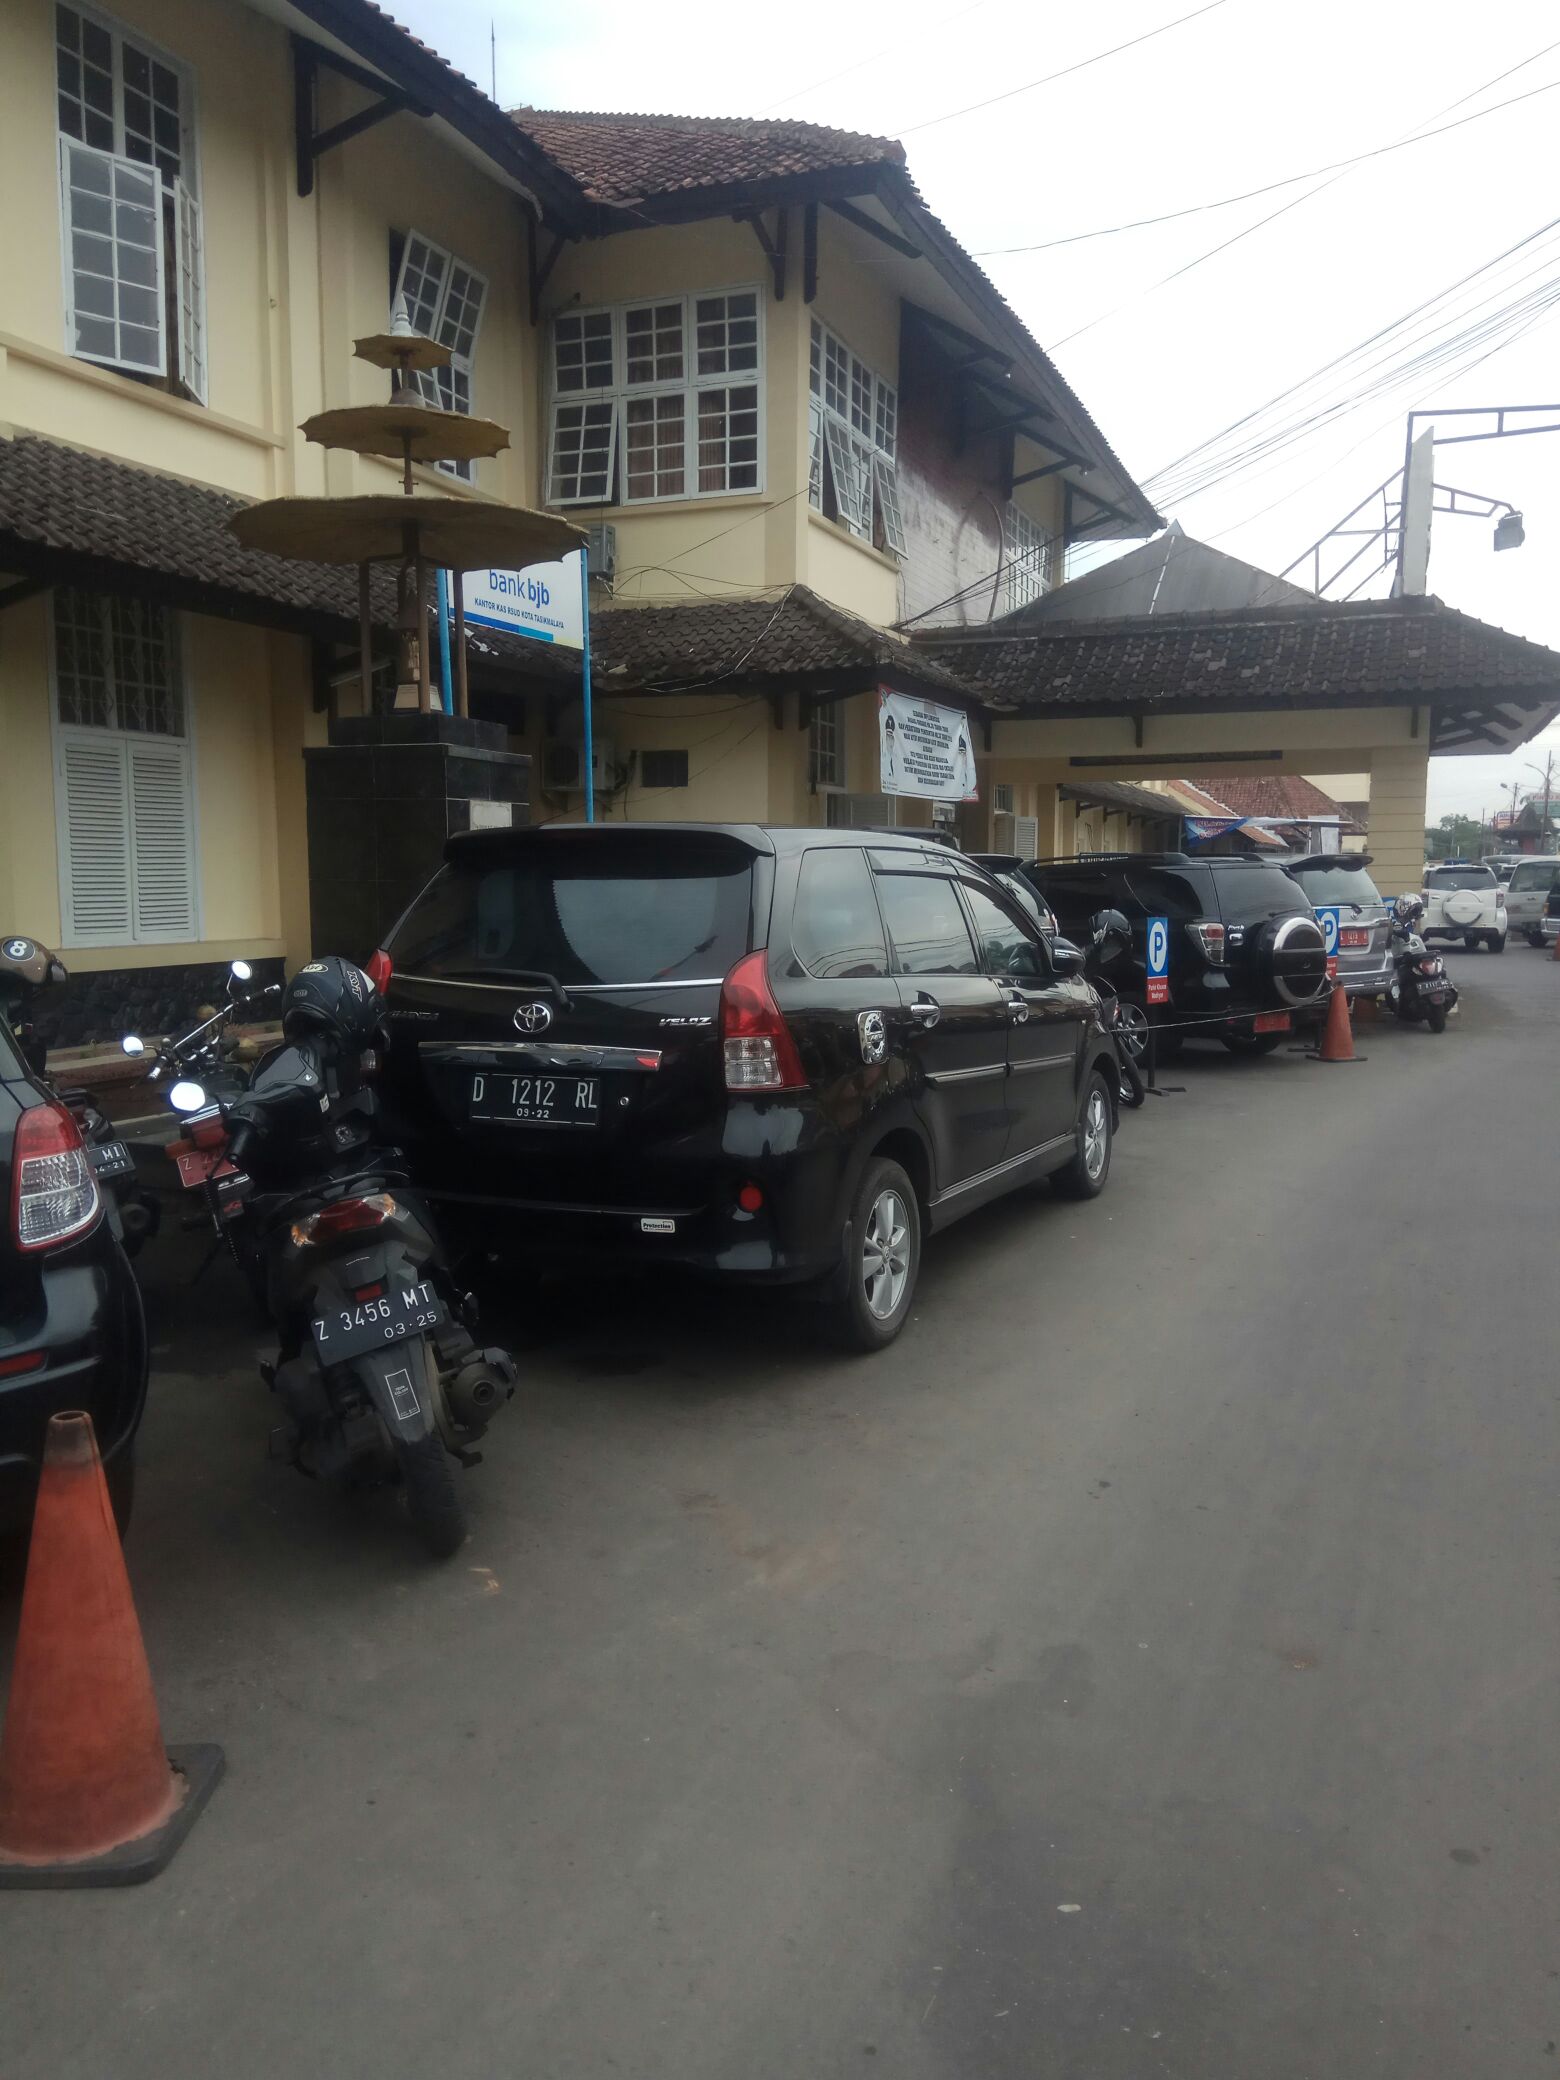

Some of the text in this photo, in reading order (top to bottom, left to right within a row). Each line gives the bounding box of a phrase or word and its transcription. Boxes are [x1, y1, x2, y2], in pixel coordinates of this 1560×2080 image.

[489, 569, 550, 608] bank bjb
[474, 597, 564, 629] KANTOR KAS RSUD KOTA TASIKMALAYA
[10, 940, 28, 957] 8
[347, 970, 363, 1003] KYT
[472, 1076, 598, 1109] D 1212 RL
[182, 1158, 194, 1170] Z
[315, 1283, 431, 1341] Z 3456 MT
